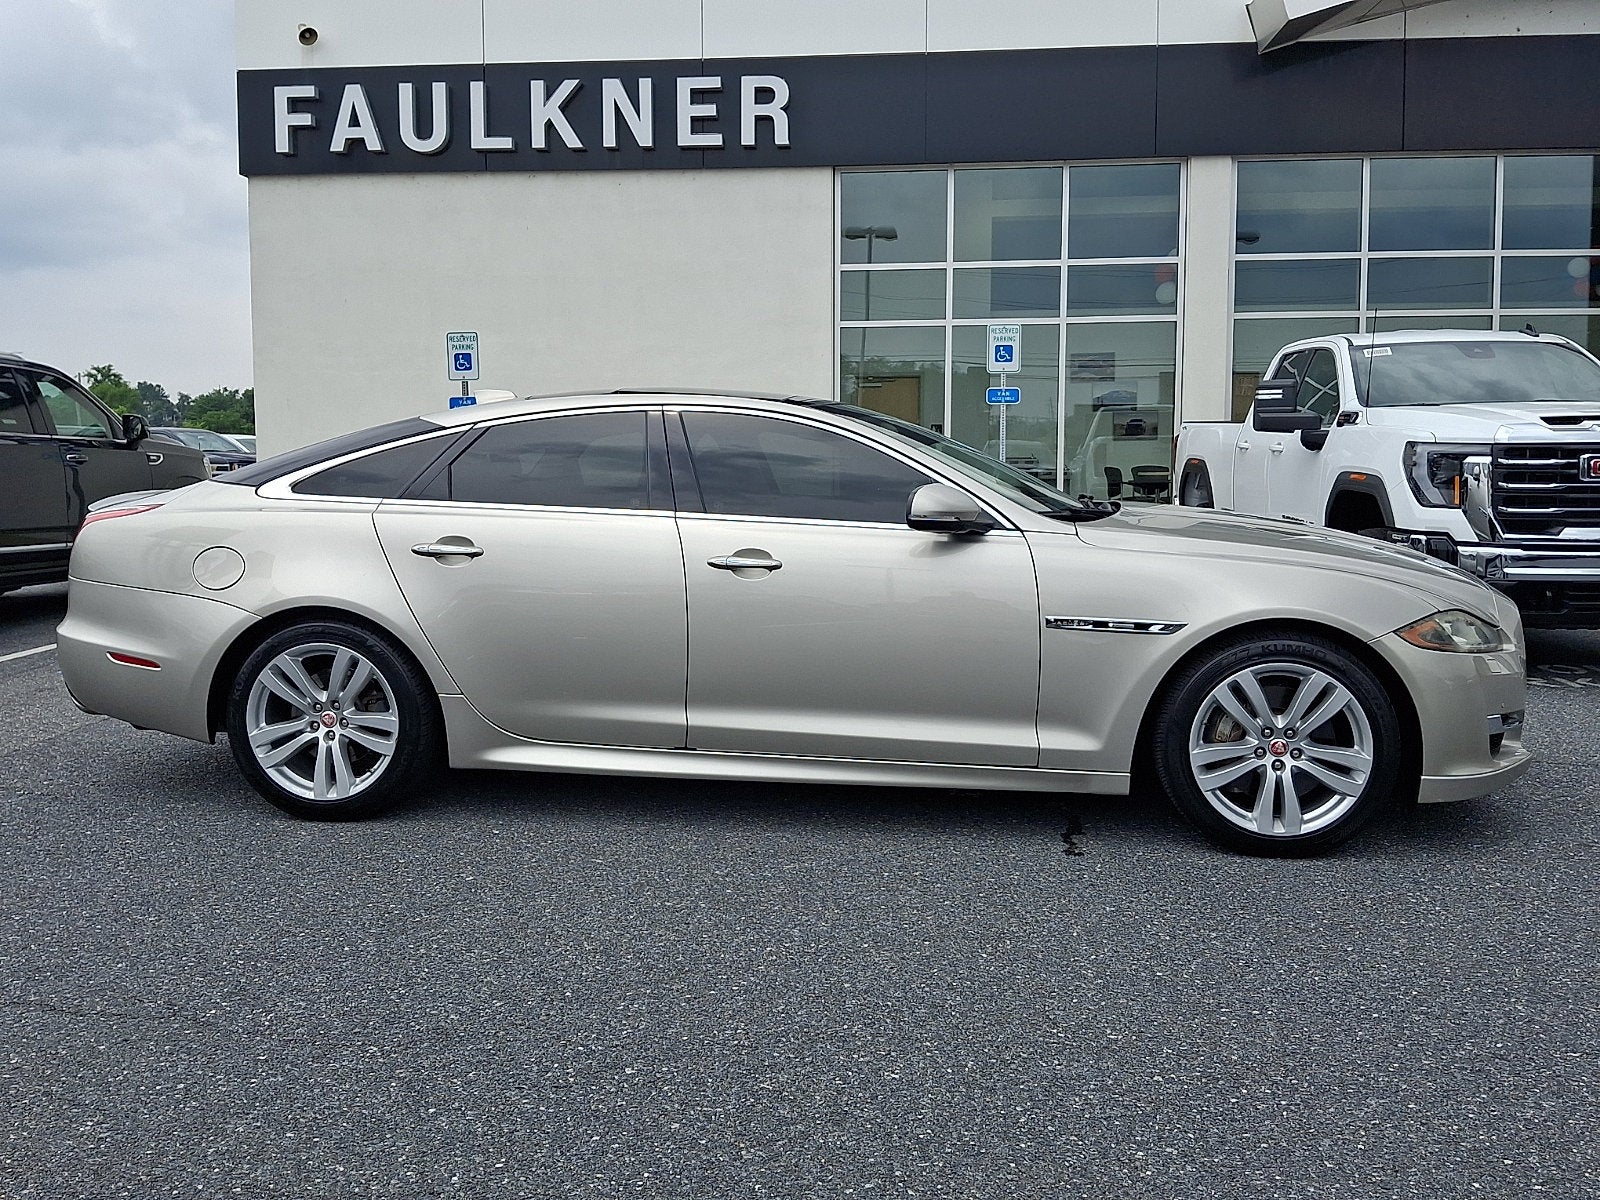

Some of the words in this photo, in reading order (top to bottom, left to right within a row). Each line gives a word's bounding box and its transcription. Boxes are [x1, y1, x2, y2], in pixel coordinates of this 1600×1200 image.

[273, 75, 791, 154] FAULKNER
[449, 335, 476, 343] RESERVED
[1262, 643, 1327, 658] KUMHO
